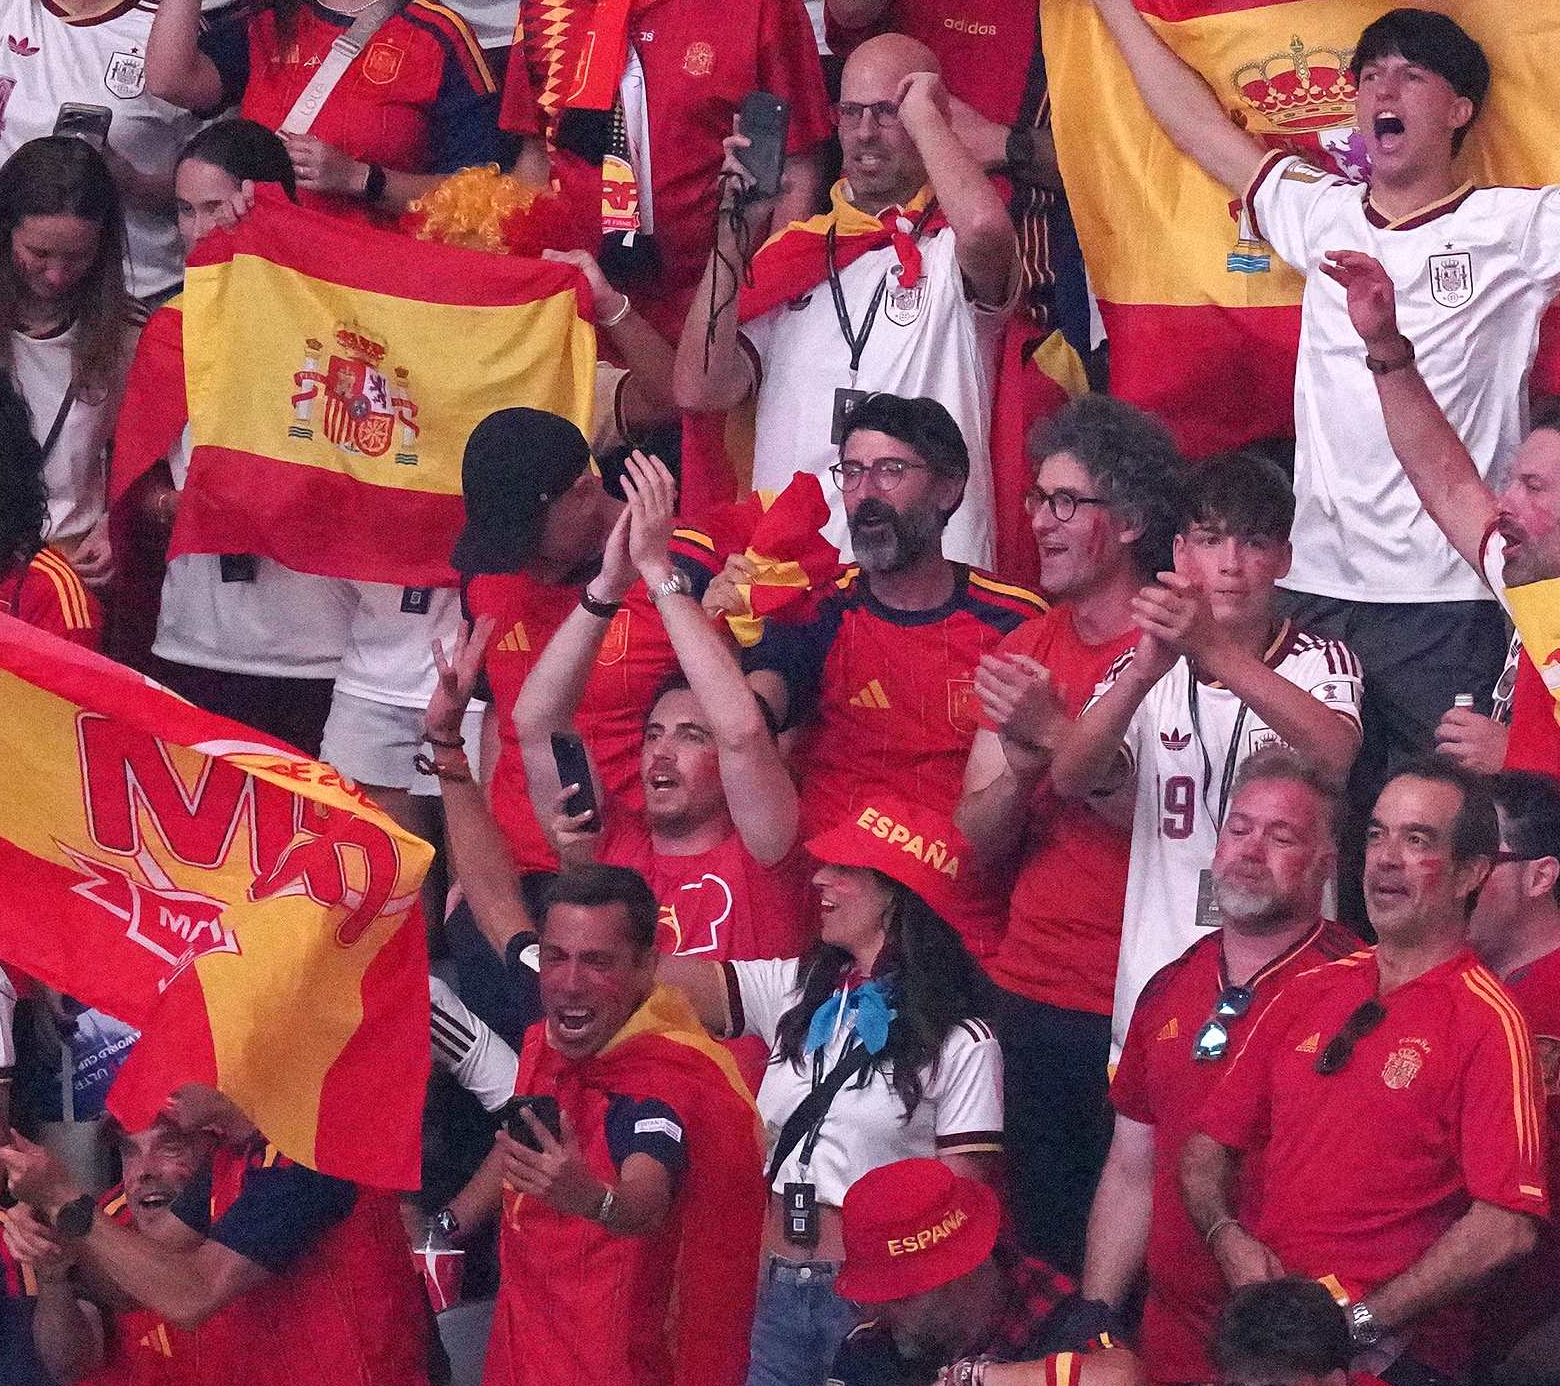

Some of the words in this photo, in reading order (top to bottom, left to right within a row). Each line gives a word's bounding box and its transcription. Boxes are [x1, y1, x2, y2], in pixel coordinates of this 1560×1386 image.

[943, 17, 997, 37] adidas
[856, 806, 960, 880] ESPAÑA
[886, 1207, 969, 1257] ESPAÑA
